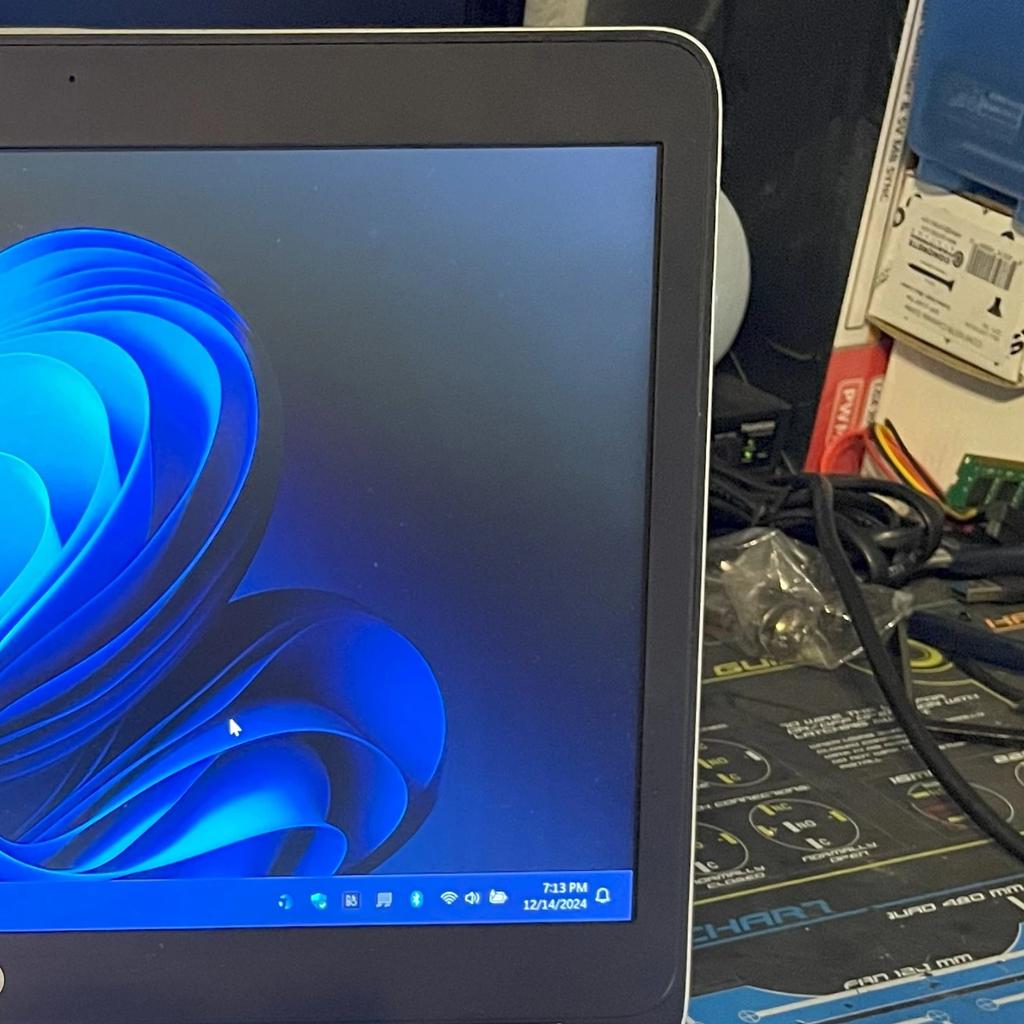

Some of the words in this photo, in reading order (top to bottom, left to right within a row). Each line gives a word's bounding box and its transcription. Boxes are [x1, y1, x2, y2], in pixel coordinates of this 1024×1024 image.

[802, 841, 877, 862] NORMALLY
[542, 881, 567, 894] 7:13
[568, 881, 588, 894] PM
[707, 872, 766, 889] CLOSED
[523, 898, 587, 911] 12/14/2024
[936, 953, 973, 968] mm
